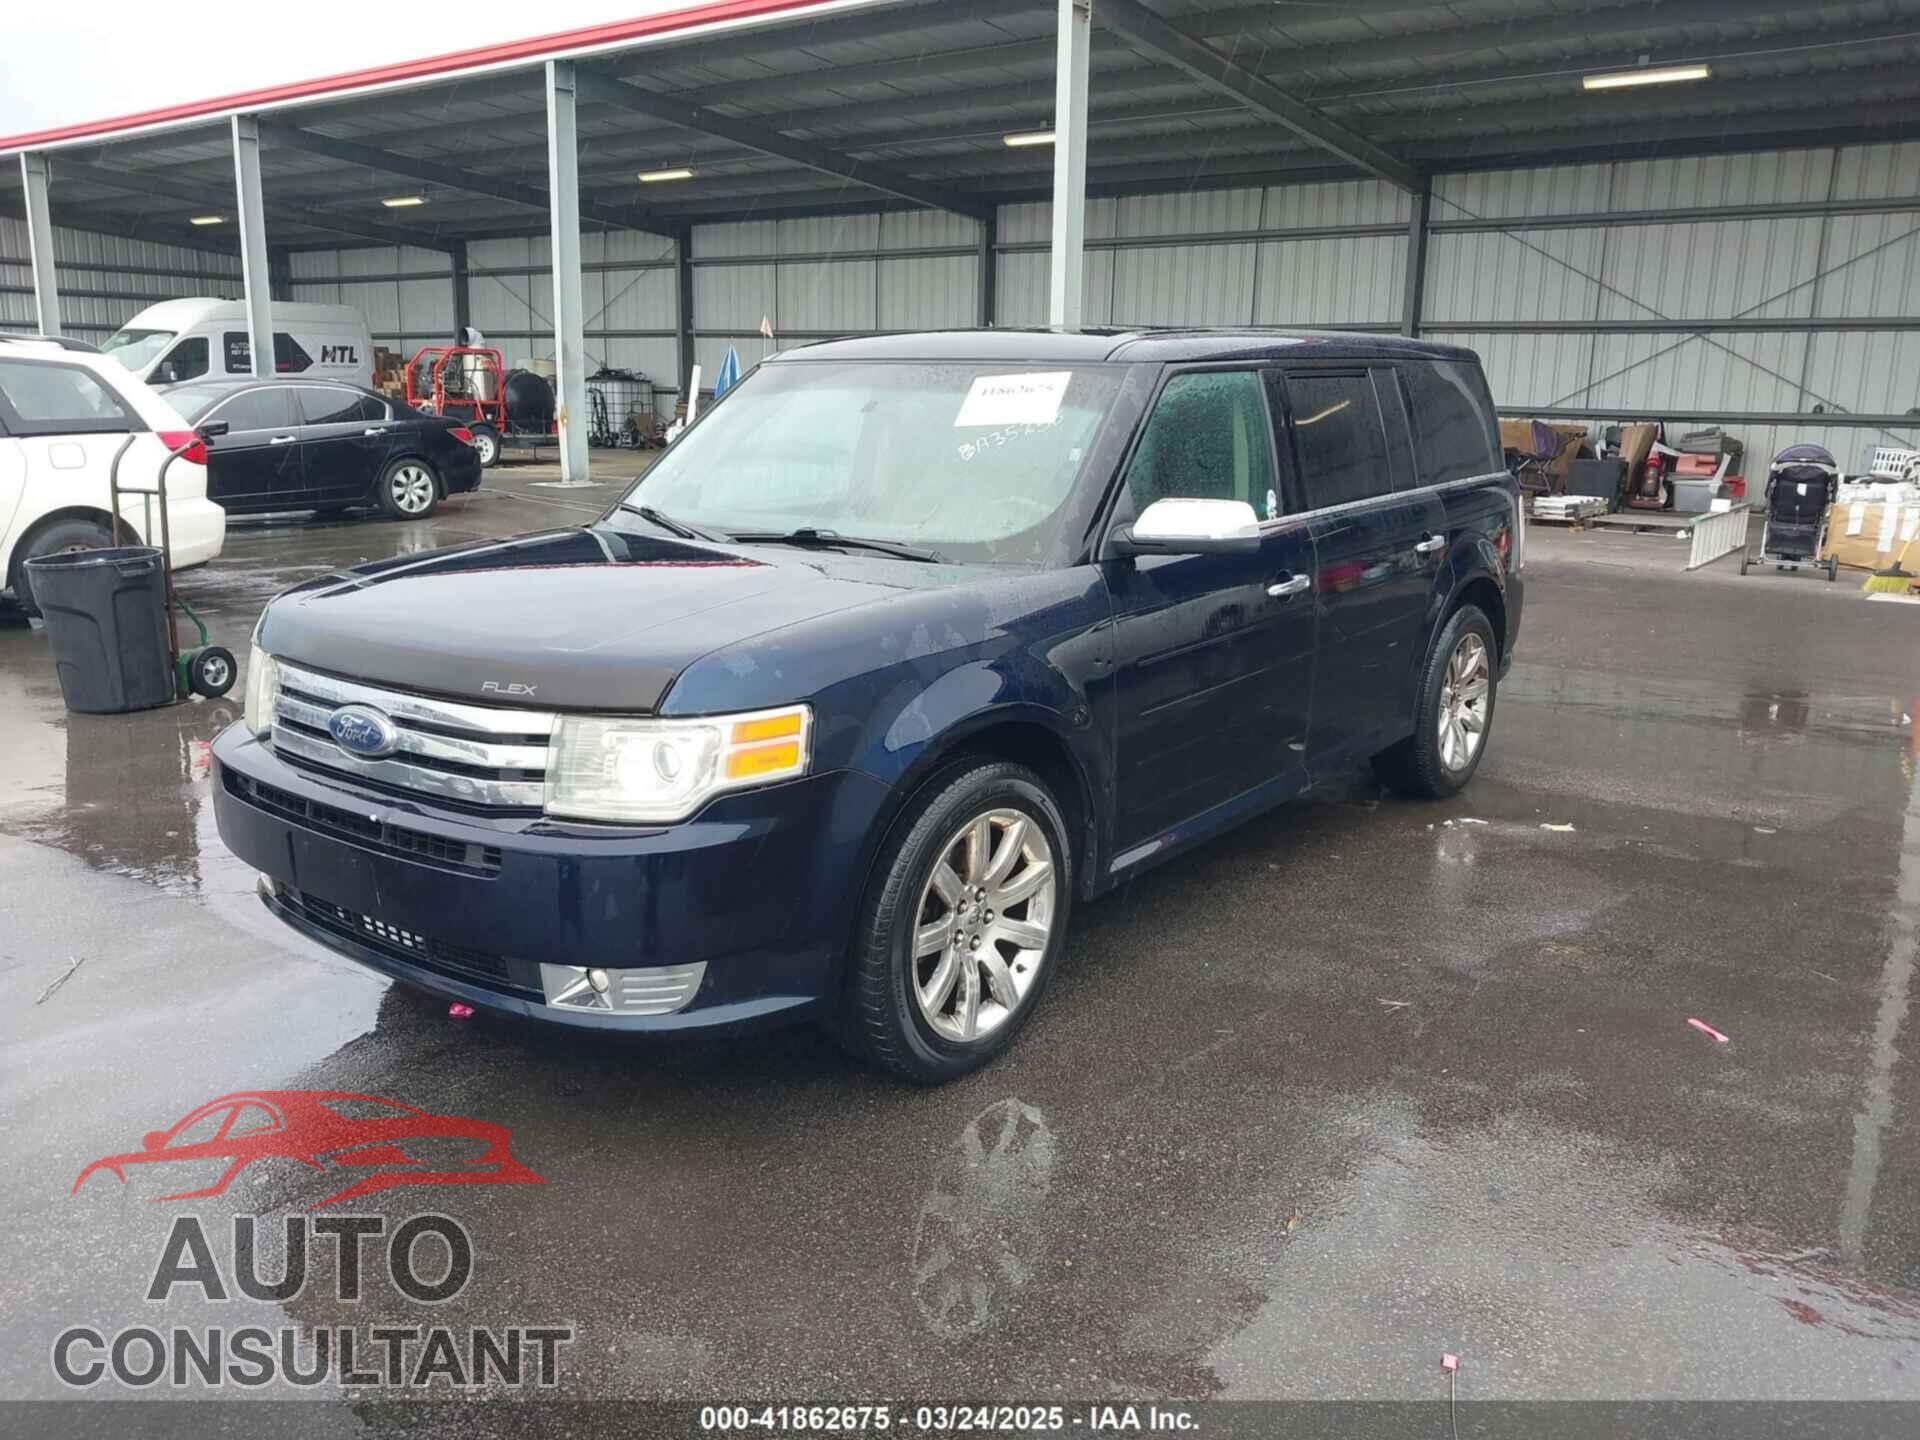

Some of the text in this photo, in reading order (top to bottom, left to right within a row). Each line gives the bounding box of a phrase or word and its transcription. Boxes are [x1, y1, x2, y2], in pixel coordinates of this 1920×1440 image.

[320, 345, 359, 363] MTL
[481, 681, 538, 696] FLEX
[336, 714, 369, 745] Ford
